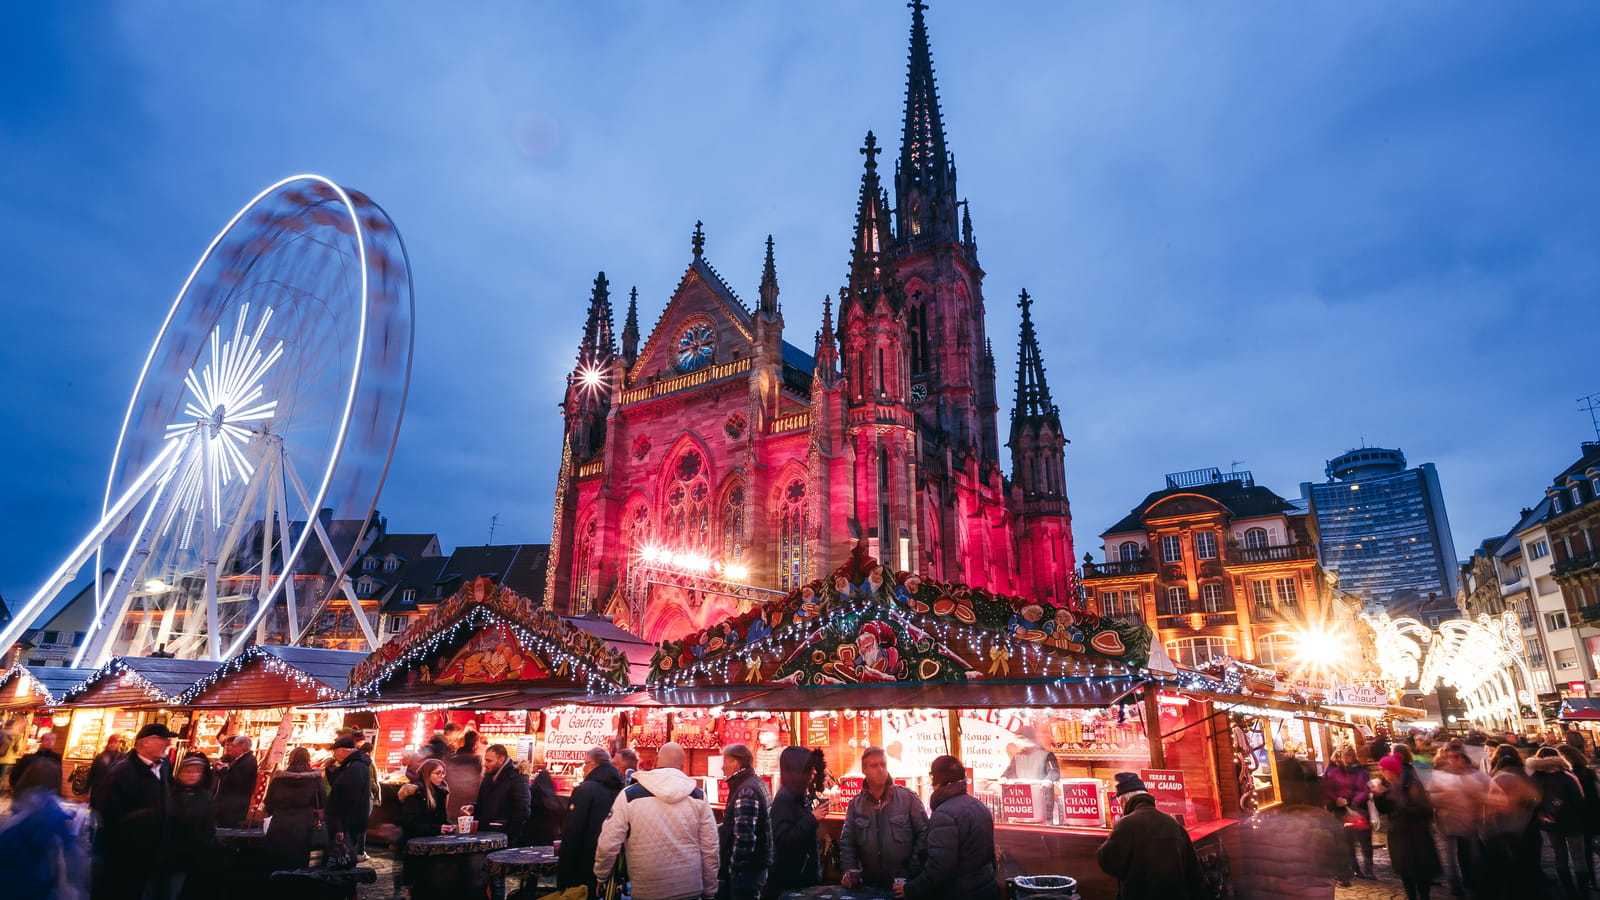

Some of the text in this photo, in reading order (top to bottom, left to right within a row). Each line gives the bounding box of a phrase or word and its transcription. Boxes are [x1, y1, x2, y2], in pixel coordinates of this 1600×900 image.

[1353, 686, 1370, 695] Vin
[1348, 693, 1377, 703] Chaud
[568, 715, 605, 729] Gaufres
[916, 732, 932, 741] Vin
[963, 732, 992, 745] Rouge
[917, 745, 933, 754] Vin
[966, 744, 993, 755] Blanc
[547, 750, 586, 760] FABRICATIO
[1143, 781, 1183, 791] VIN CHAUD
[1009, 788, 1024, 796] VIN
[1071, 788, 1088, 796] VIN
[1066, 806, 1098, 814] BLANC
